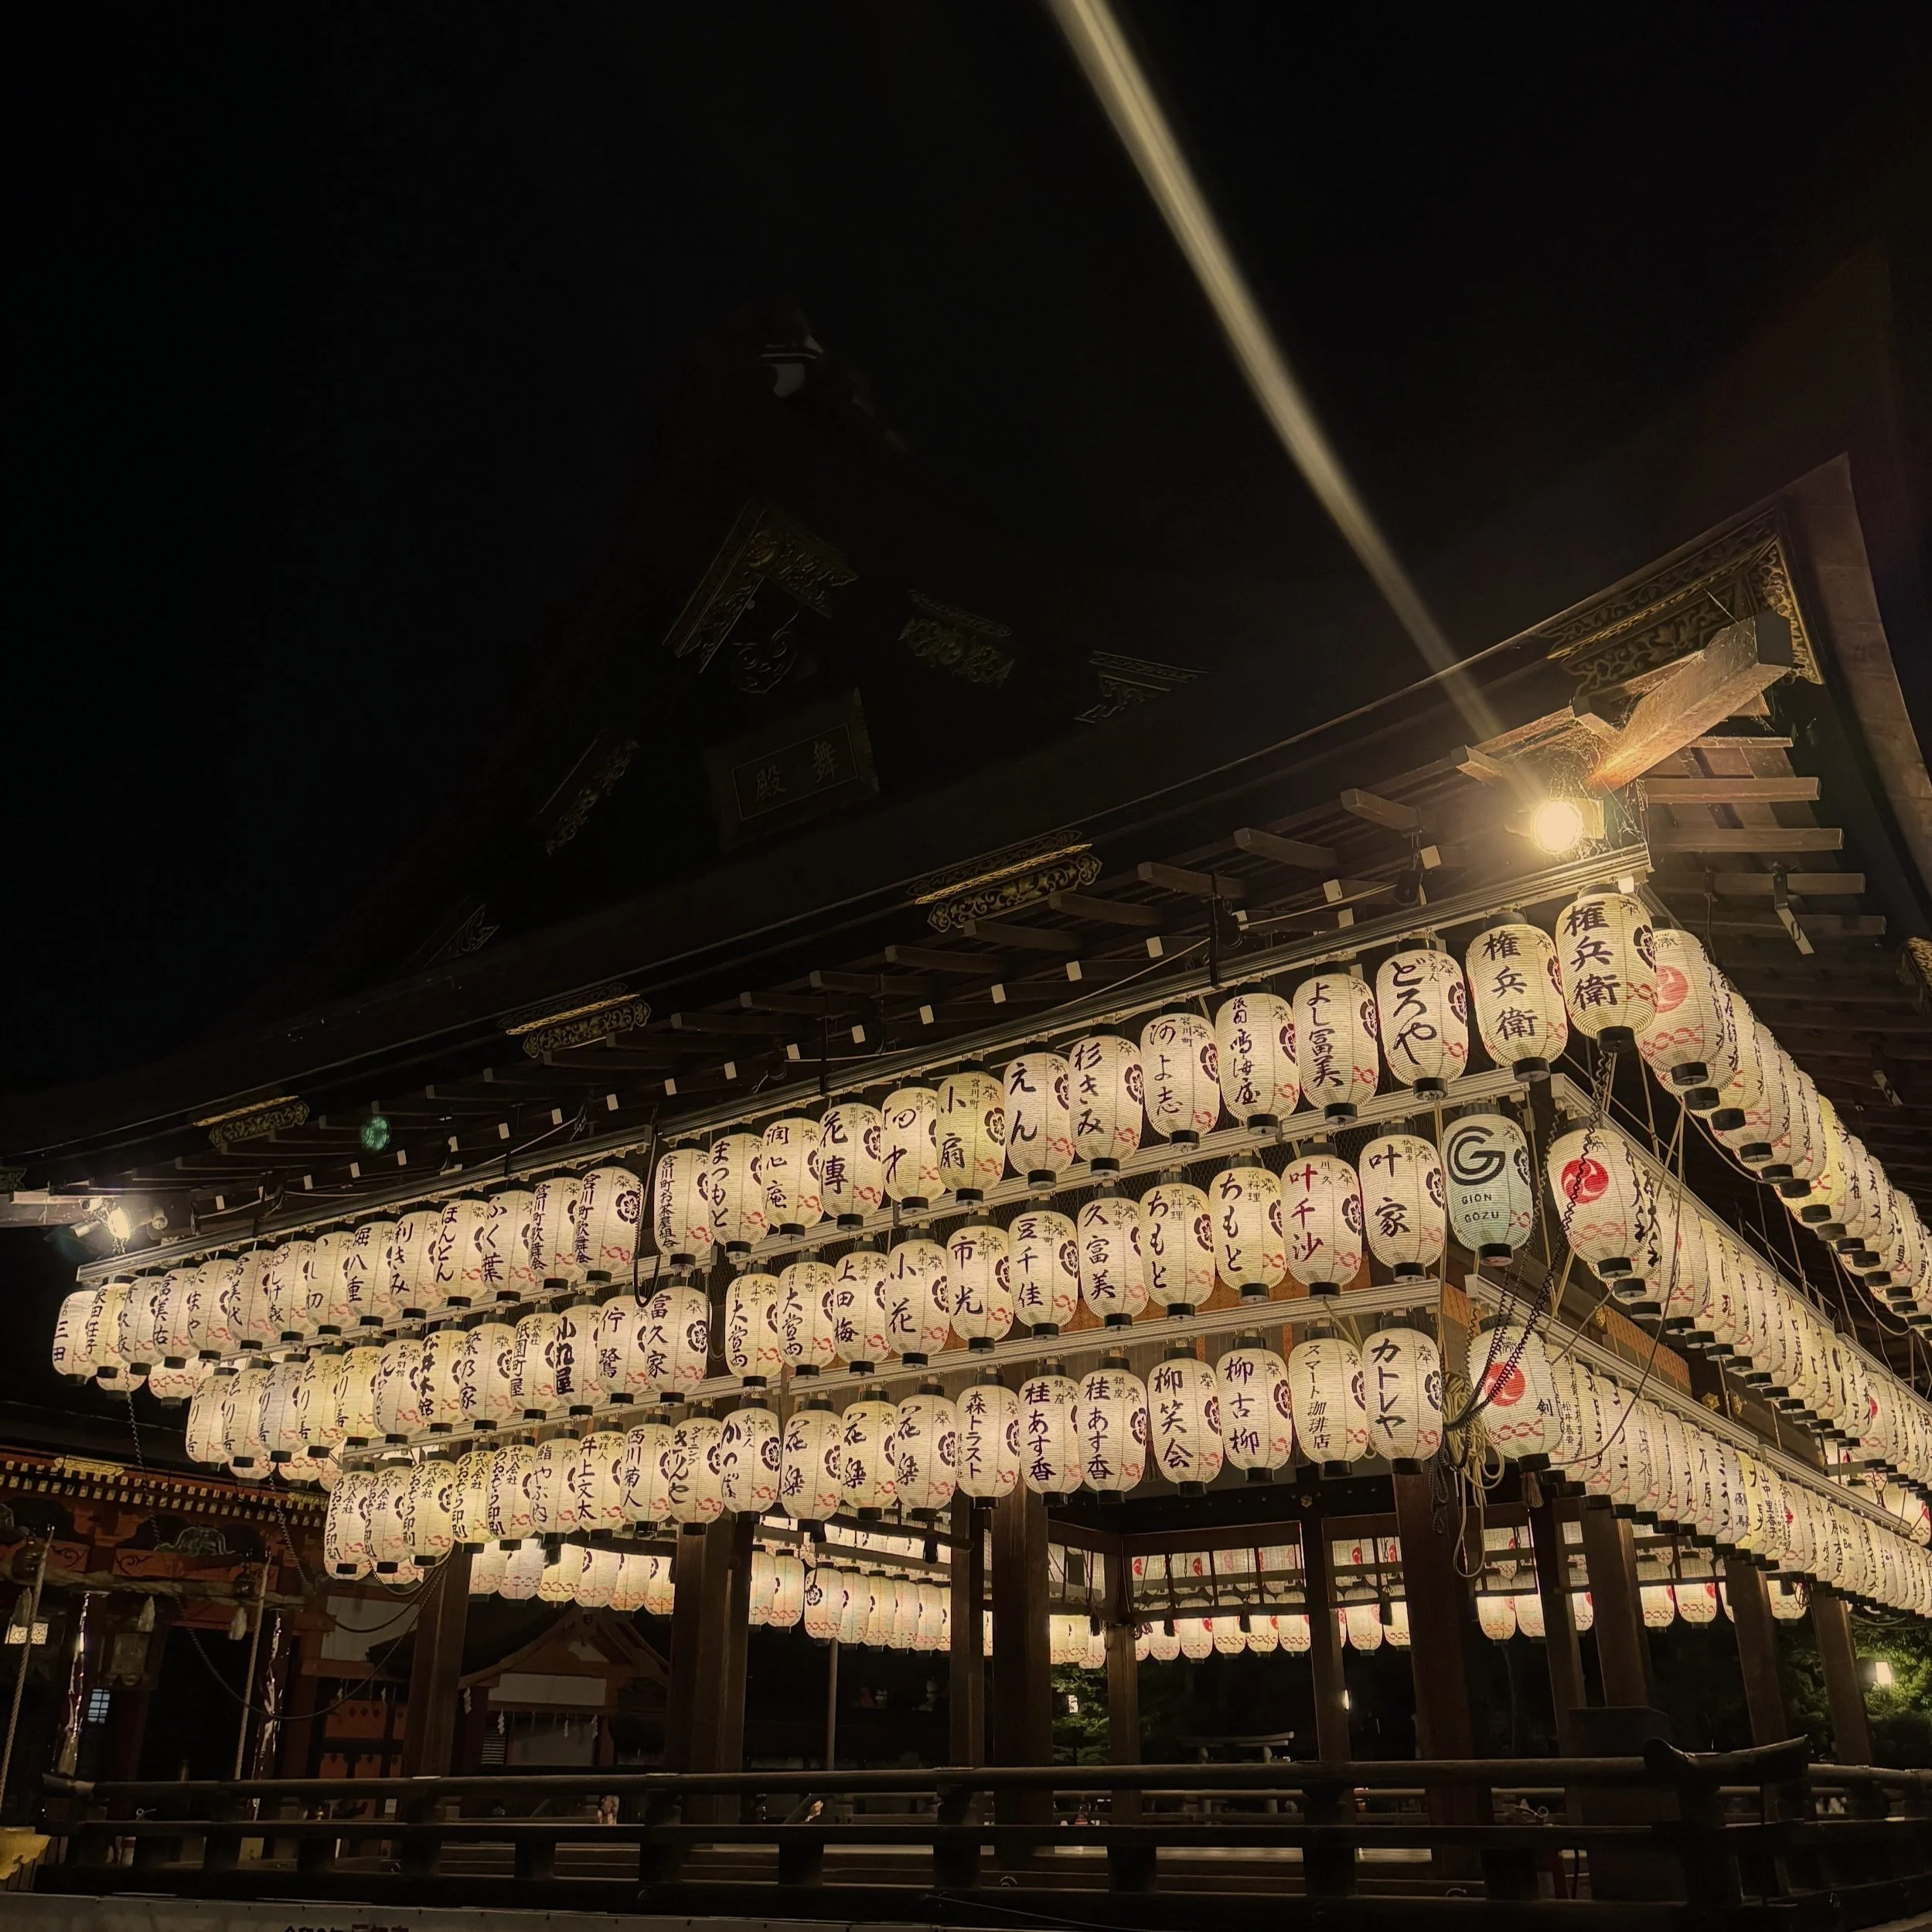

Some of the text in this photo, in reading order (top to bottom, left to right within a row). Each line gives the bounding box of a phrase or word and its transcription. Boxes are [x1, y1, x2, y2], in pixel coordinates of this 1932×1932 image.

[1482, 931, 1538, 1041] 権兵衛
[1563, 901, 1621, 1012] 権兵衛
[1391, 958, 1437, 1065] どろや
[939, 1085, 966, 1169] 小扇
[1009, 1062, 1037, 1145] えん
[710, 1140, 731, 1228] まつもと
[1170, 1189, 1184, 1222] 京料理
[1248, 1170, 1261, 1203] 京料理
[1289, 1164, 1324, 1262] 叶千沙
[1320, 1161, 1332, 1185] 川久
[1368, 1144, 1411, 1238] 叶家
[1462, 1193, 1492, 1205] GION
[1465, 1211, 1500, 1223] GOZU
[574, 1174, 601, 1263] 宮川町歌舞会
[1043, 1215, 1055, 1246] 先斗町
[1085, 1204, 1116, 1300] 久富美
[1147, 1191, 1169, 1289] ちもと
[1220, 1173, 1243, 1273] ちもと
[833, 1259, 860, 1343] 上田梅
[888, 1252, 916, 1334] 小花
[951, 1236, 984, 1316] 市光
[1017, 1218, 1044, 1308] 豆千佳
[646, 1293, 673, 1378] 富久家
[1024, 1382, 1057, 1481] 桂あす香
[1054, 1379, 1065, 1405] 銀座
[1084, 1376, 1114, 1480] 桂あす香
[1154, 1367, 1194, 1469] 柳笑会
[1224, 1357, 1260, 1455] 柳古柳
[1304, 1344, 1331, 1450] スマート珈琲店
[1371, 1338, 1406, 1439] カトレヤ
[1536, 1398, 1553, 1416] 剣
[506, 1445, 523, 1485] 株式会社
[577, 1436, 598, 1520] 井上文太
[688, 1426, 704, 1466] ダイニング
[965, 1391, 986, 1480] 森トラスト
